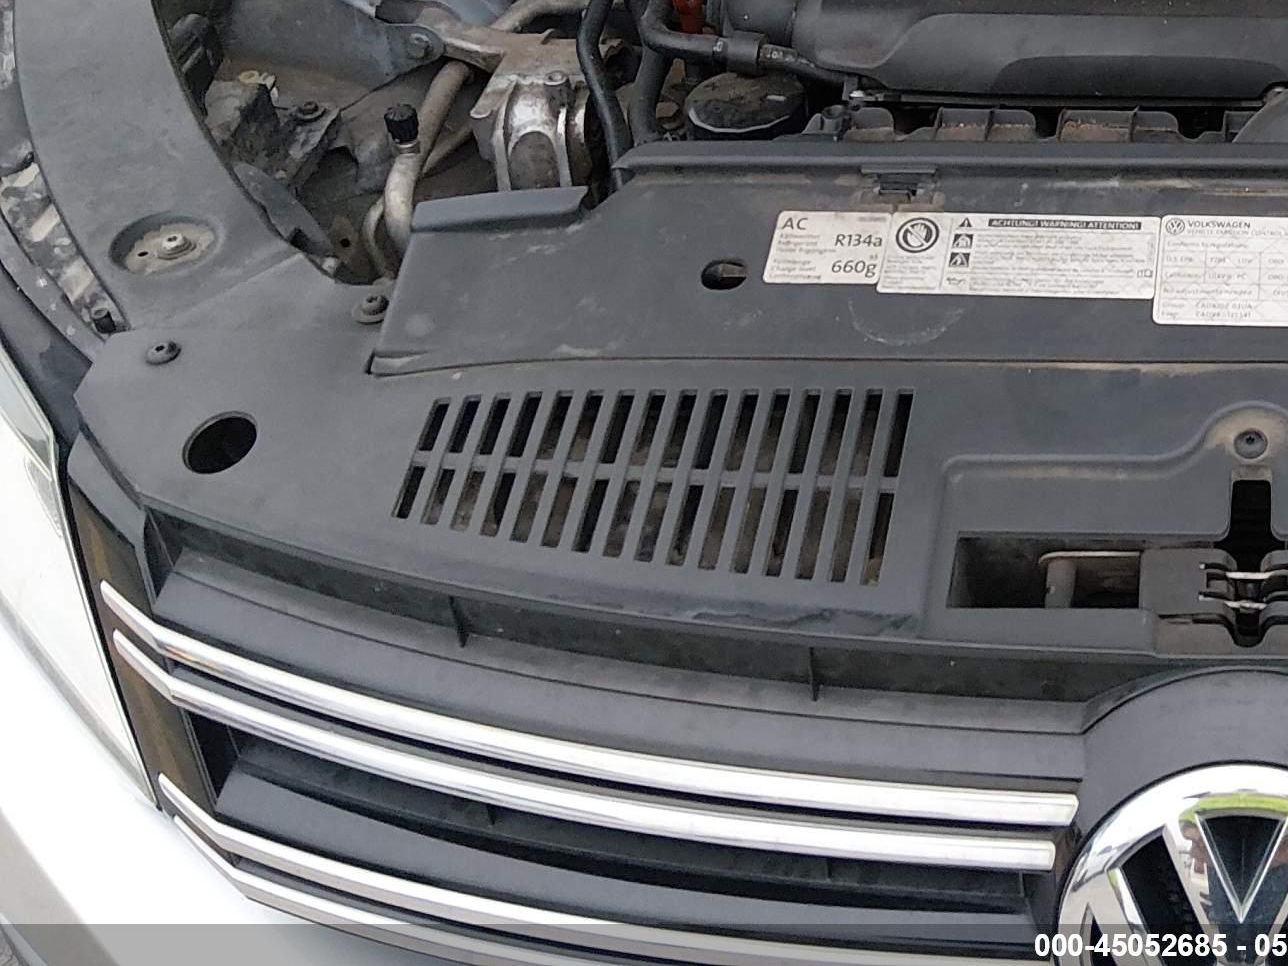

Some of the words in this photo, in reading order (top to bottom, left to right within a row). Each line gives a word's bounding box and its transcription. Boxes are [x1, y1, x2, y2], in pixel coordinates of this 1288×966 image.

[781, 217, 808, 230] AC
[990, 218, 1039, 228] ACHTUNG!
[1040, 220, 1086, 229] WARNING!
[1088, 221, 1140, 230] ATTENTION!
[1187, 220, 1251, 229] VOLKSWAGEN
[834, 233, 883, 247] R134a
[831, 259, 878, 278] 660g
